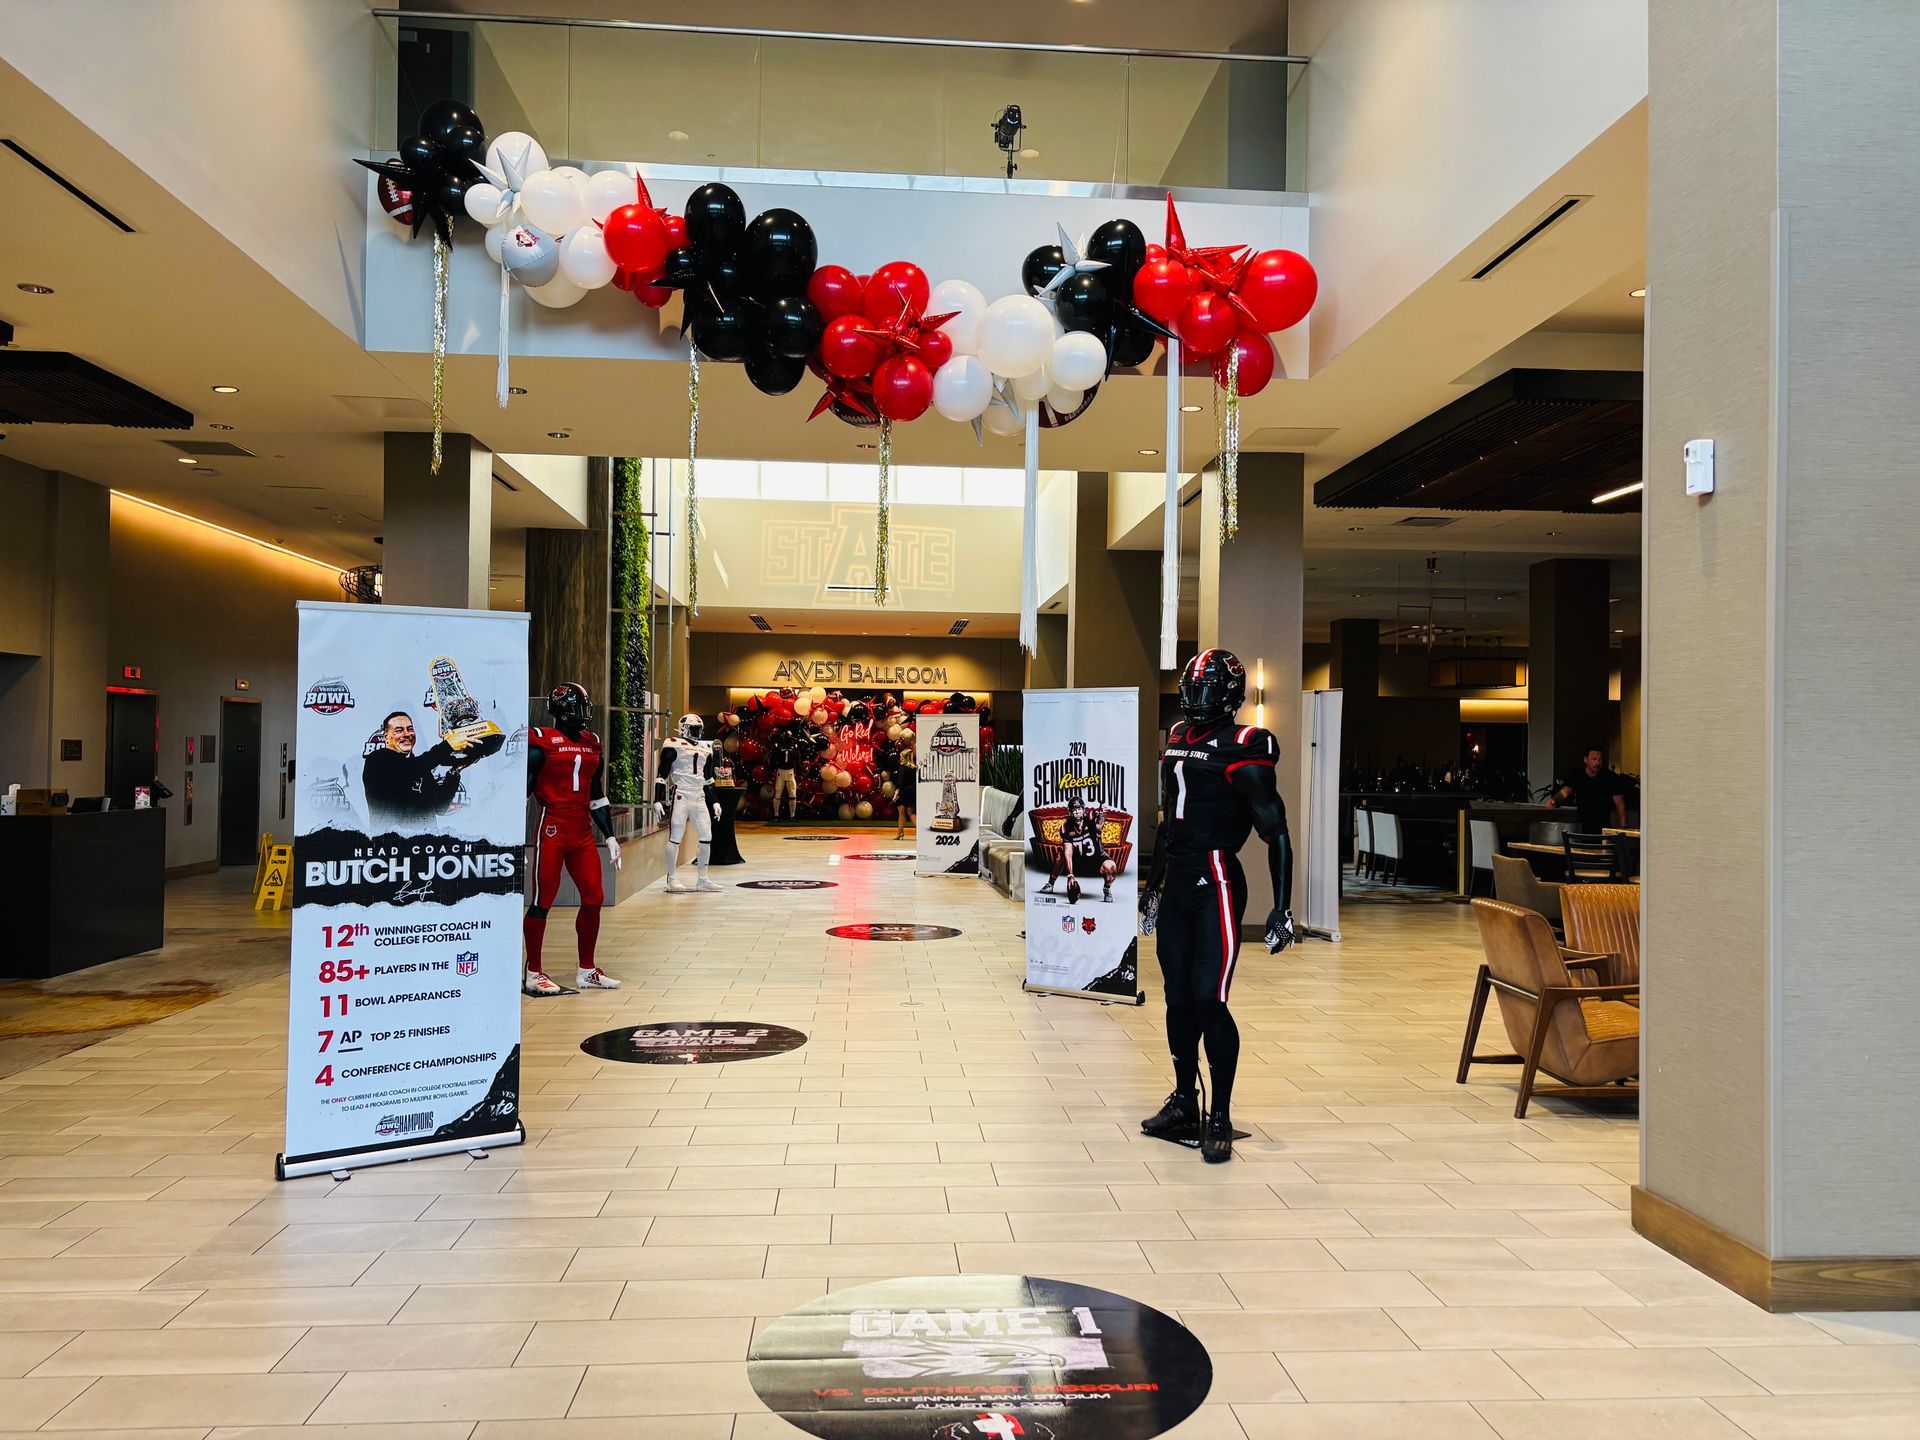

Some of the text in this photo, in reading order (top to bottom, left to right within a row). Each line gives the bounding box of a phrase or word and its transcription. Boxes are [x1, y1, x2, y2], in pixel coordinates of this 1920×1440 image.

[761, 502, 956, 608] STATE
[772, 660, 948, 687] ARVEST BALLROOM
[305, 692, 354, 706] BOWL
[932, 736, 966, 747] BOWL
[1069, 742, 1087, 757] 2024
[1266, 735, 1273, 755] 1
[573, 754, 582, 791] 1
[693, 753, 698, 774] 1
[1033, 757, 1127, 812] SENIOR BOWL
[1059, 773, 1101, 790] Reese's
[1173, 760, 1187, 820] 1
[935, 835, 960, 846] 2024
[1072, 837, 1095, 857] 73
[354, 844, 473, 858] HEAD COACH
[305, 853, 515, 888] BUTCH JONES
[322, 920, 491, 949] 12th WINNINGEST COACH IN
[374, 932, 472, 947] COLLEGE FOOTBALL
[318, 959, 450, 984] 85+ PLAYERS IN THE
[458, 960, 478, 975] NFL
[320, 989, 461, 1018] 11 BOWL APPEARANCES
[317, 1025, 451, 1053] 7 AP TOP 25 FINISHES
[632, 1028, 770, 1038] GAME 2
[315, 1051, 498, 1087] 4 CONFERENCE CHAMPIONSHIPS
[331, 1096, 347, 1104] ONLY
[347, 1093, 372, 1102] CURRENT
[388, 1088, 410, 1096] COACH
[417, 1084, 441, 1093] COLLEGE
[442, 1080, 467, 1089] FOOTBALL
[350, 1103, 364, 1111] LEAD
[369, 1098, 401, 1109] PROGRAMS
[410, 1094, 432, 1103] MULTIPLE
[849, 1306, 1102, 1339] GAME 1
[813, 1383, 1160, 1397] VS. SOUTHEAST MISSOURI
[864, 1395, 977, 1403] CENTENNIAL
[914, 1402, 986, 1410] AUGUST
